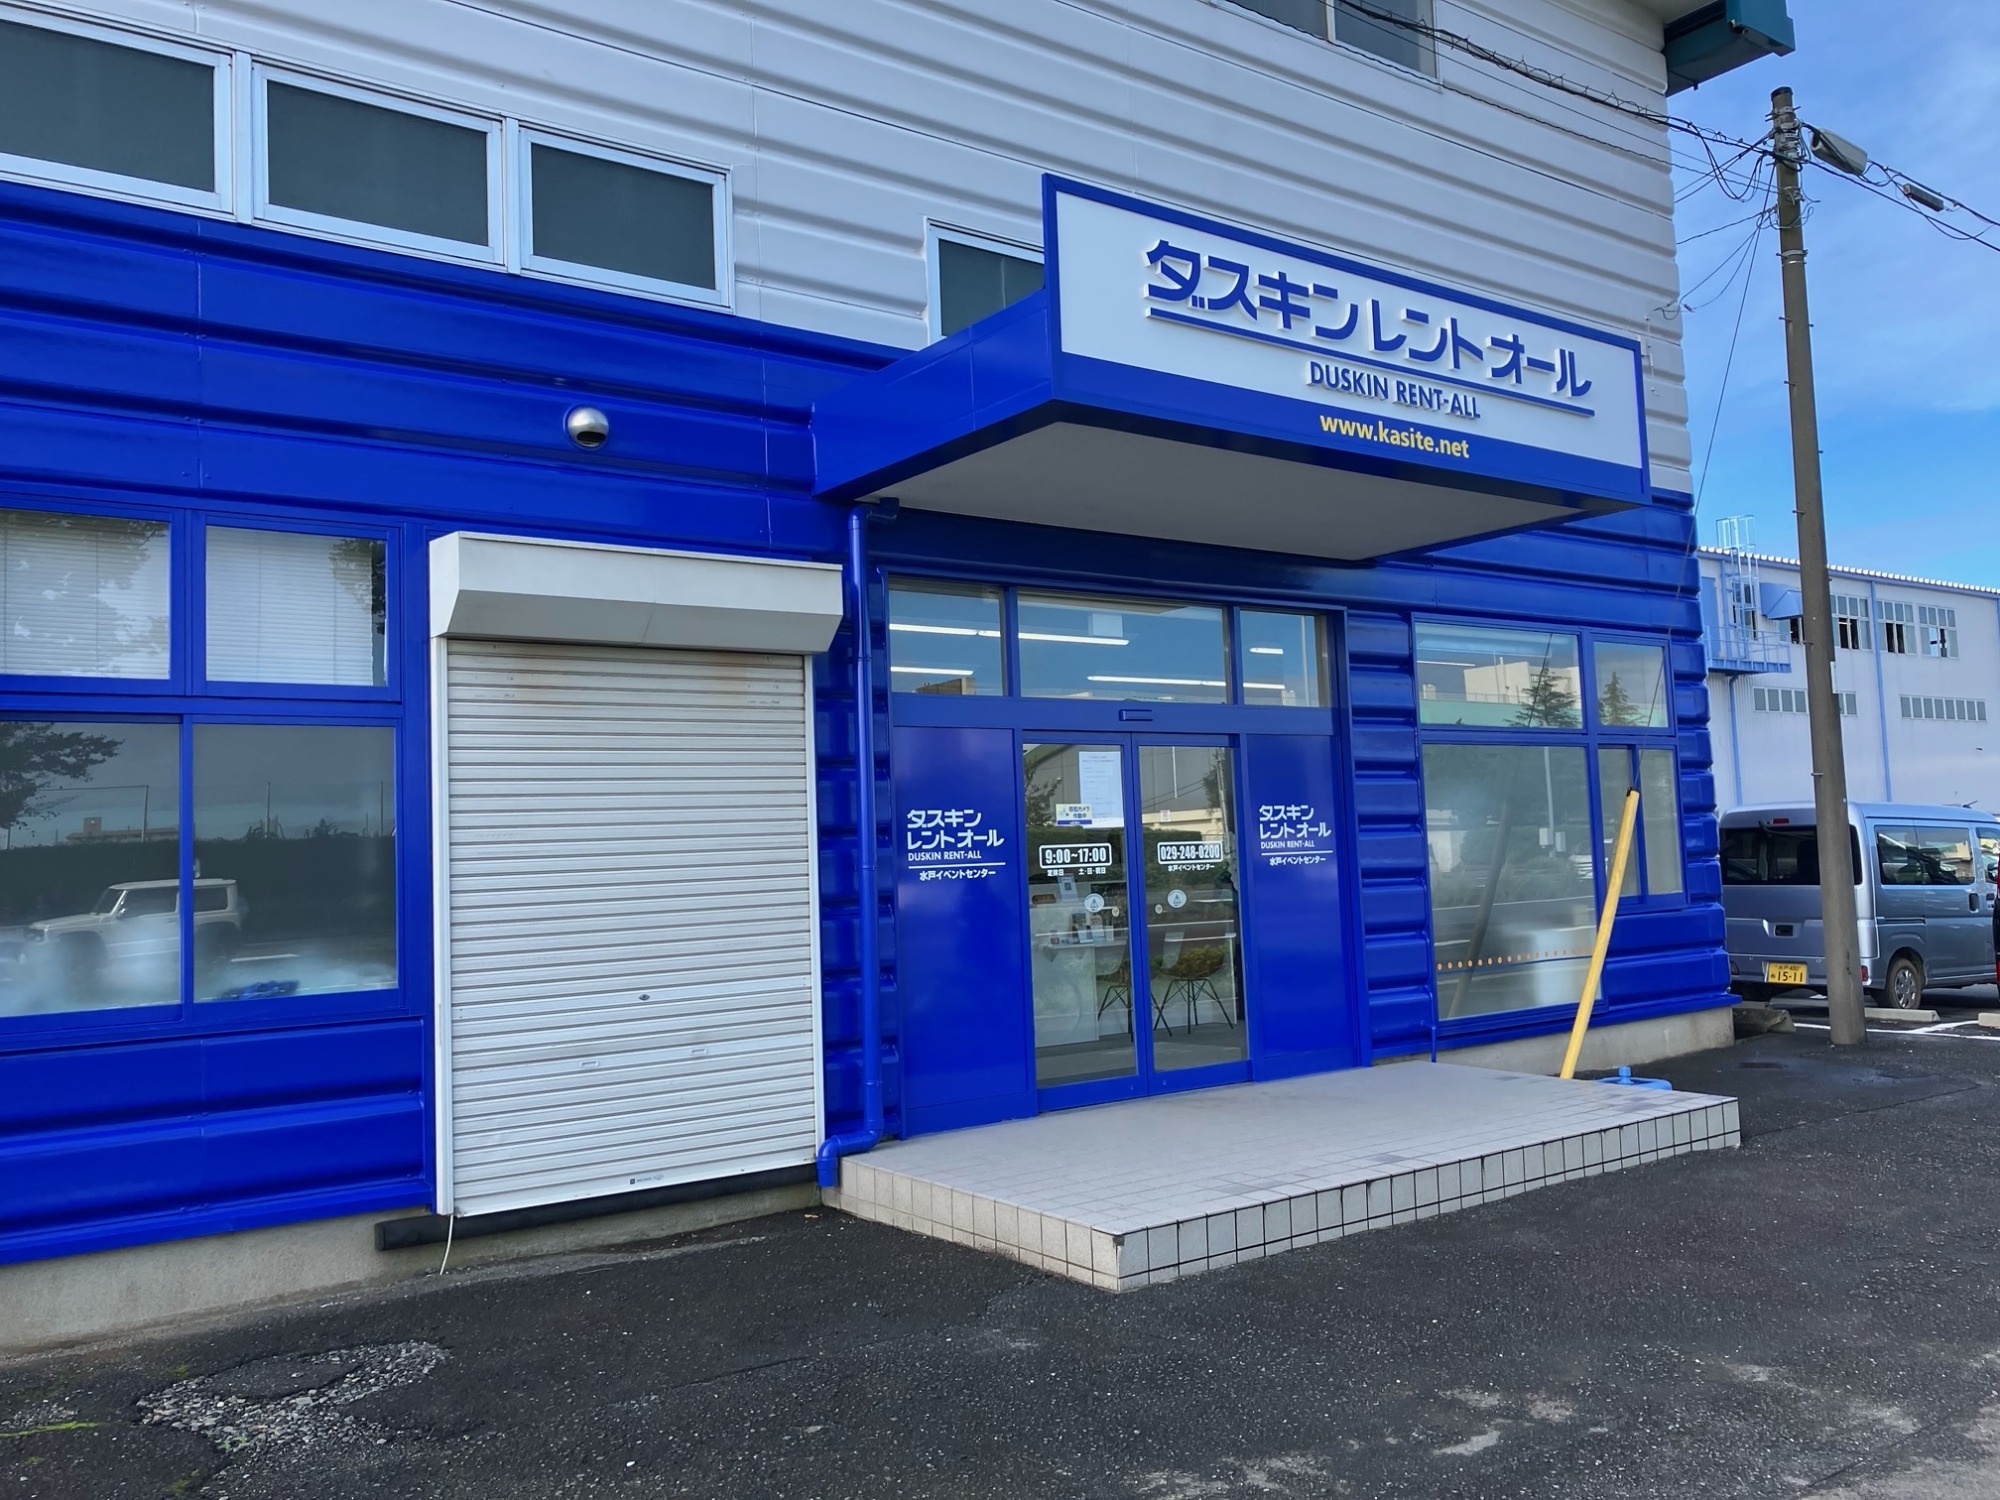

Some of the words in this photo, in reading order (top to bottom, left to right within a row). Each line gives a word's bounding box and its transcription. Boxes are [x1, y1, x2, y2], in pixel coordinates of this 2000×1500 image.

[1144, 239, 1592, 398] ダスキンレントオール
[1307, 360, 1389, 401] DUSKIN
[1395, 380, 1481, 420] RENT-ALL
[1319, 411, 1470, 460] www.kasite.net
[907, 808, 981, 829] ダスキン
[1259, 804, 1314, 821] ダスキン
[1260, 822, 1332, 839] レントオール
[907, 829, 1005, 850] レントオール
[1260, 840, 1286, 849] DUSKIN
[1286, 839, 1315, 848] RENT-ALL
[908, 851, 941, 861] DUSKIN
[943, 850, 982, 860] RENT-ALL
[1160, 844, 1220, 860] 029-248-0200
[1167, 863, 1215, 872] 水戸イベントセンター
[1269, 855, 1327, 866] 水戸イベントセンター
[919, 868, 996, 881] 水戸イベントセンター
[1047, 868, 1065, 877] 定休日
[1778, 971, 1803, 982] 15-11
